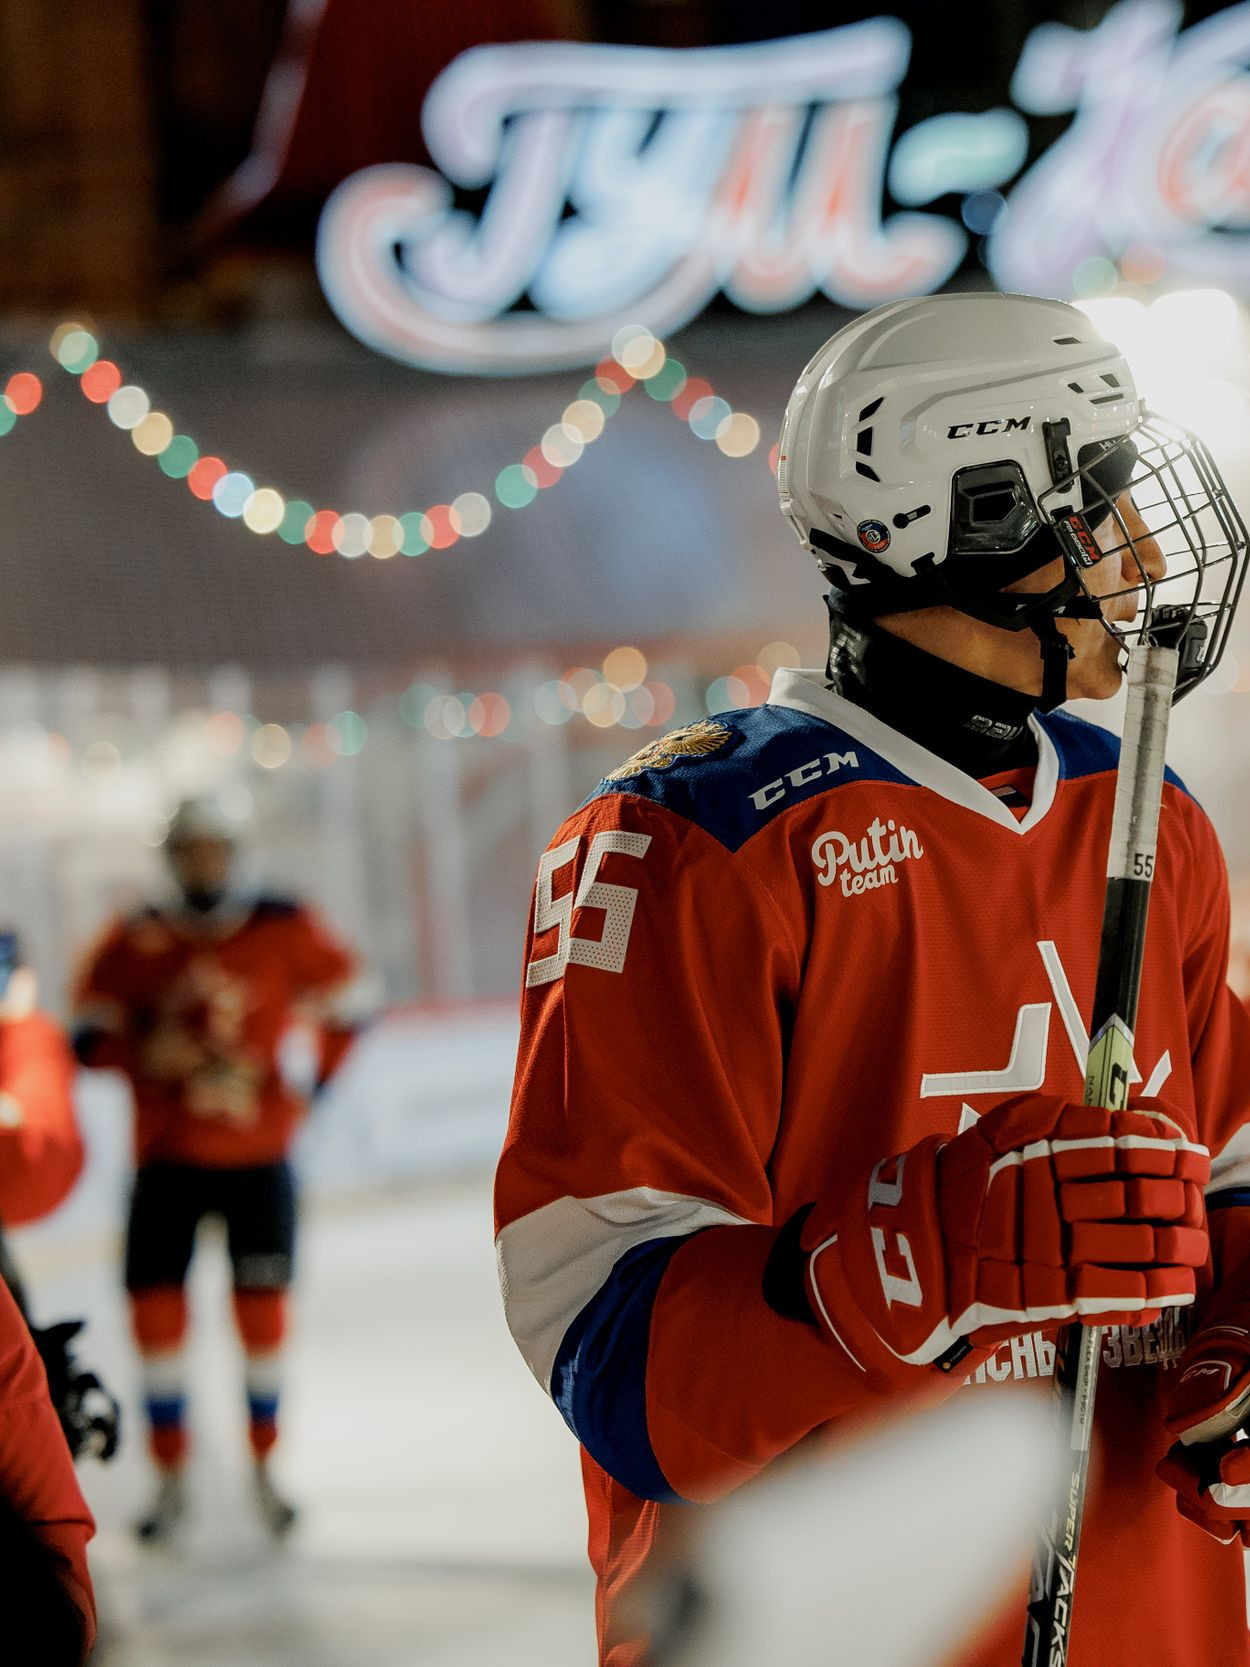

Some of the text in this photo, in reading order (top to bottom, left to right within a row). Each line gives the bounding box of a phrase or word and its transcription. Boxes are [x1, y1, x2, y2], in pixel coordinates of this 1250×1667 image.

[947, 416, 1032, 440] CCM
[1069, 516, 1100, 560] CCM
[748, 751, 860, 811] CCM
[811, 817, 924, 886] Putin
[1133, 853, 1155, 878] 55
[839, 864, 899, 898] team
[1064, 1471, 1080, 1552] SUPER
